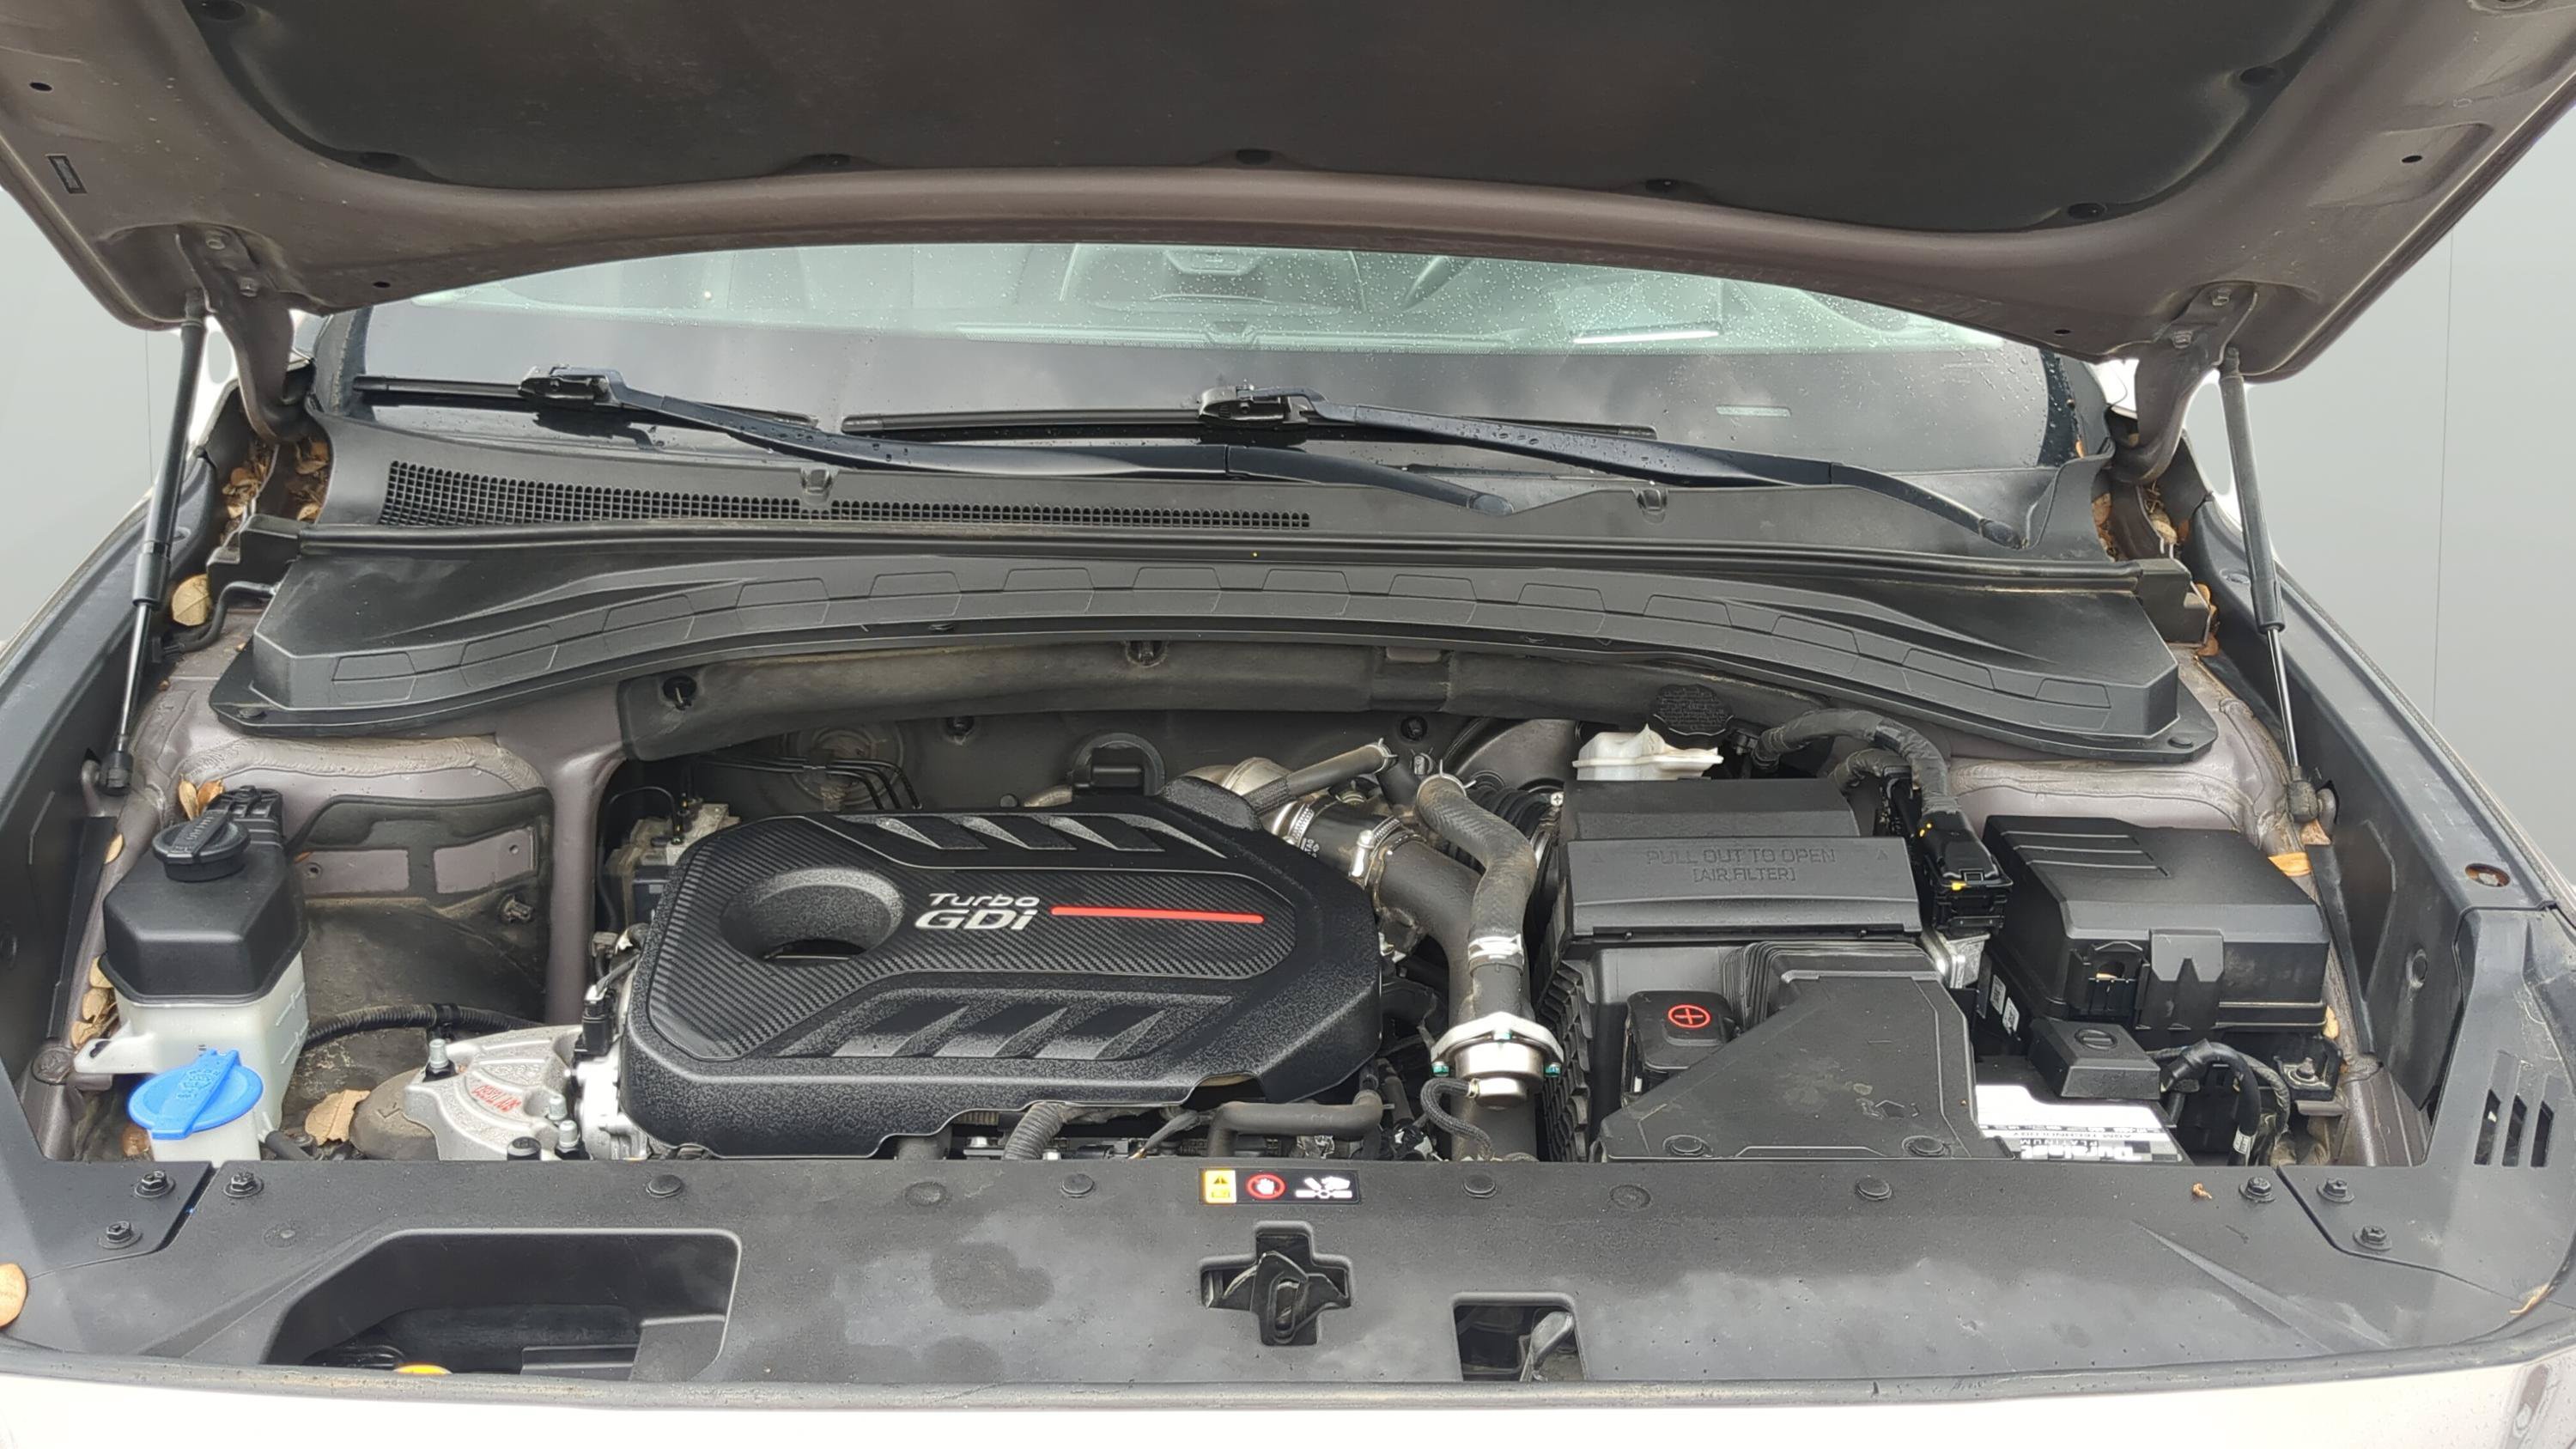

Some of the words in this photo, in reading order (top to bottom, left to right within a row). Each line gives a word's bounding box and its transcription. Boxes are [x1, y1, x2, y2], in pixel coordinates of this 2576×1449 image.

[1645, 847, 1698, 865] PULL
[1703, 847, 1744, 864] OUT
[1747, 847, 1776, 863] TO
[1781, 847, 1837, 863] OPEN
[928, 892, 1041, 908] Turbo
[914, 908, 1039, 931] GDi
[2020, 1138, 2099, 1148] PLATINUM
